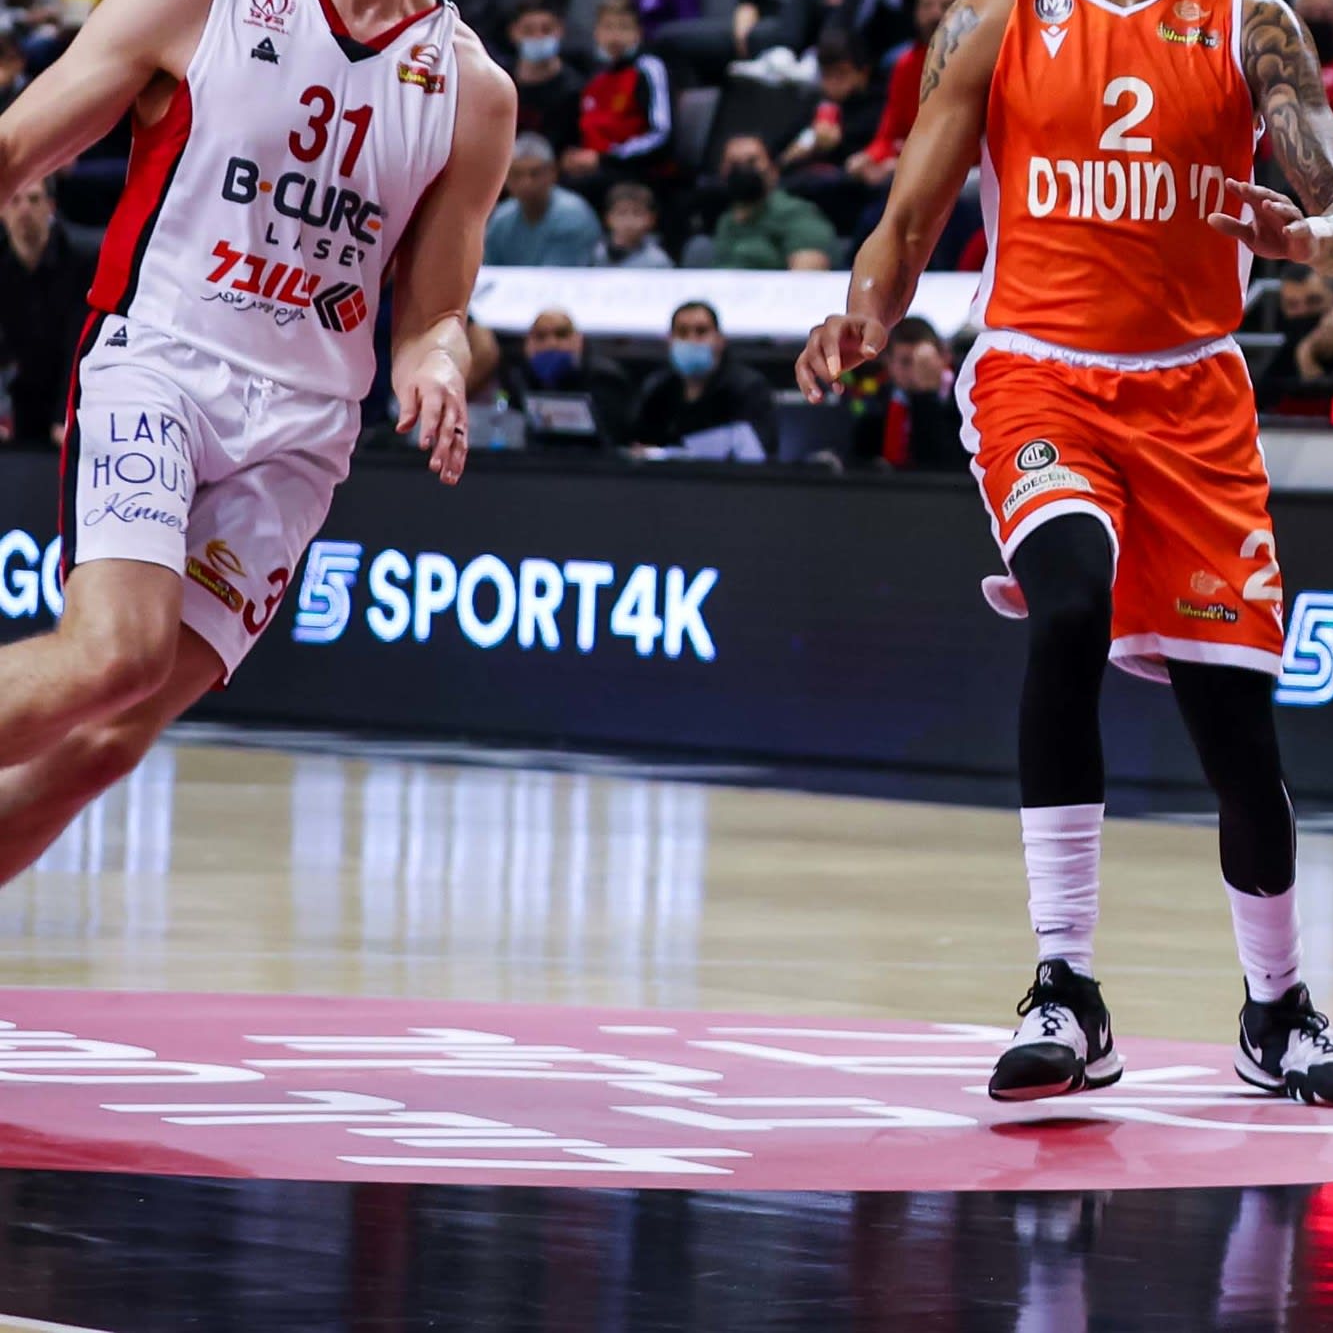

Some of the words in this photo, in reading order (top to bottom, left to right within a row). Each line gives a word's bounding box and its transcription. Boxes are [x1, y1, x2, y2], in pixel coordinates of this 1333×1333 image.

[289, 85, 373, 178] 31
[1099, 77, 1154, 152] 2
[1028, 156, 1176, 221] מוטורס
[206, 240, 321, 307] שובל
[1240, 529, 1283, 600] 2
[243, 568, 289, 636] 3
[366, 547, 718, 660] SPORT4K
